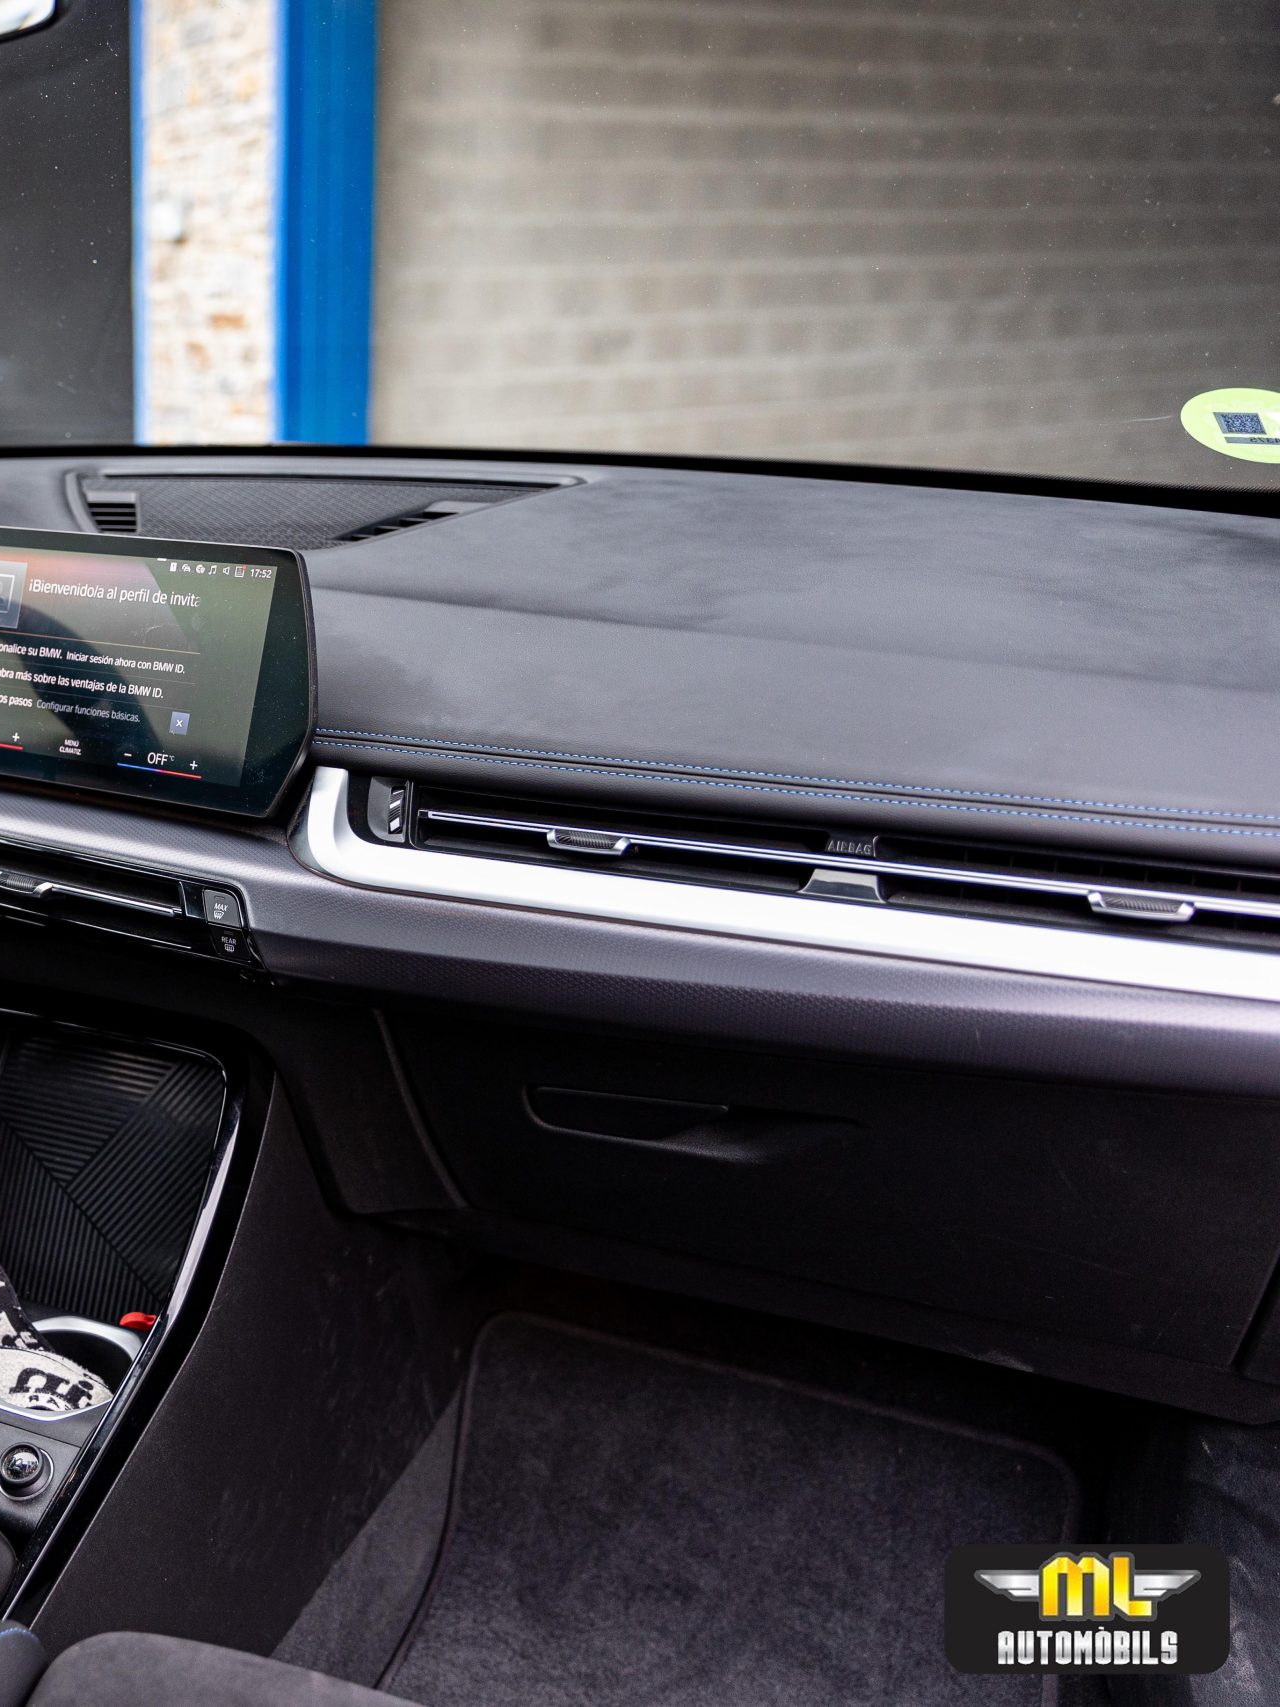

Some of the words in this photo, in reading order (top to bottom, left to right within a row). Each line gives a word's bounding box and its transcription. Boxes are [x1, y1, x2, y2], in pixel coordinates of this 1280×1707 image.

[250, 568, 272, 579] 17:52
[106, 587, 117, 600] al
[119, 589, 150, 603] perfil
[152, 590, 168, 604] de
[28, 646, 39, 656] su
[39, 646, 63, 660] BMW.
[66, 650, 88, 663] Iniciar
[89, 653, 114, 666] sesión
[114, 657, 136, 669] ahora
[137, 660, 152, 670] con
[152, 660, 175, 674] BMW
[174, 663, 186, 674] ID.
[15, 667, 33, 681] más
[33, 670, 57, 685] sobre
[58, 674, 70, 687] las
[70, 676, 105, 692] ventajas
[106, 680, 117, 692] de
[118, 682, 127, 694] la
[128, 684, 152, 697] BMW
[152, 688, 164, 699] ID.
[9, 695, 33, 708] pasos
[36, 699, 74, 715] Configurar
[74, 704, 111, 719] funciones
[111, 709, 141, 723] básicas.
[147, 751, 169, 766] OFF
[826, 839, 873, 856] AIRBAG
[213, 902, 229, 912] MAX
[221, 936, 237, 945] REAR
